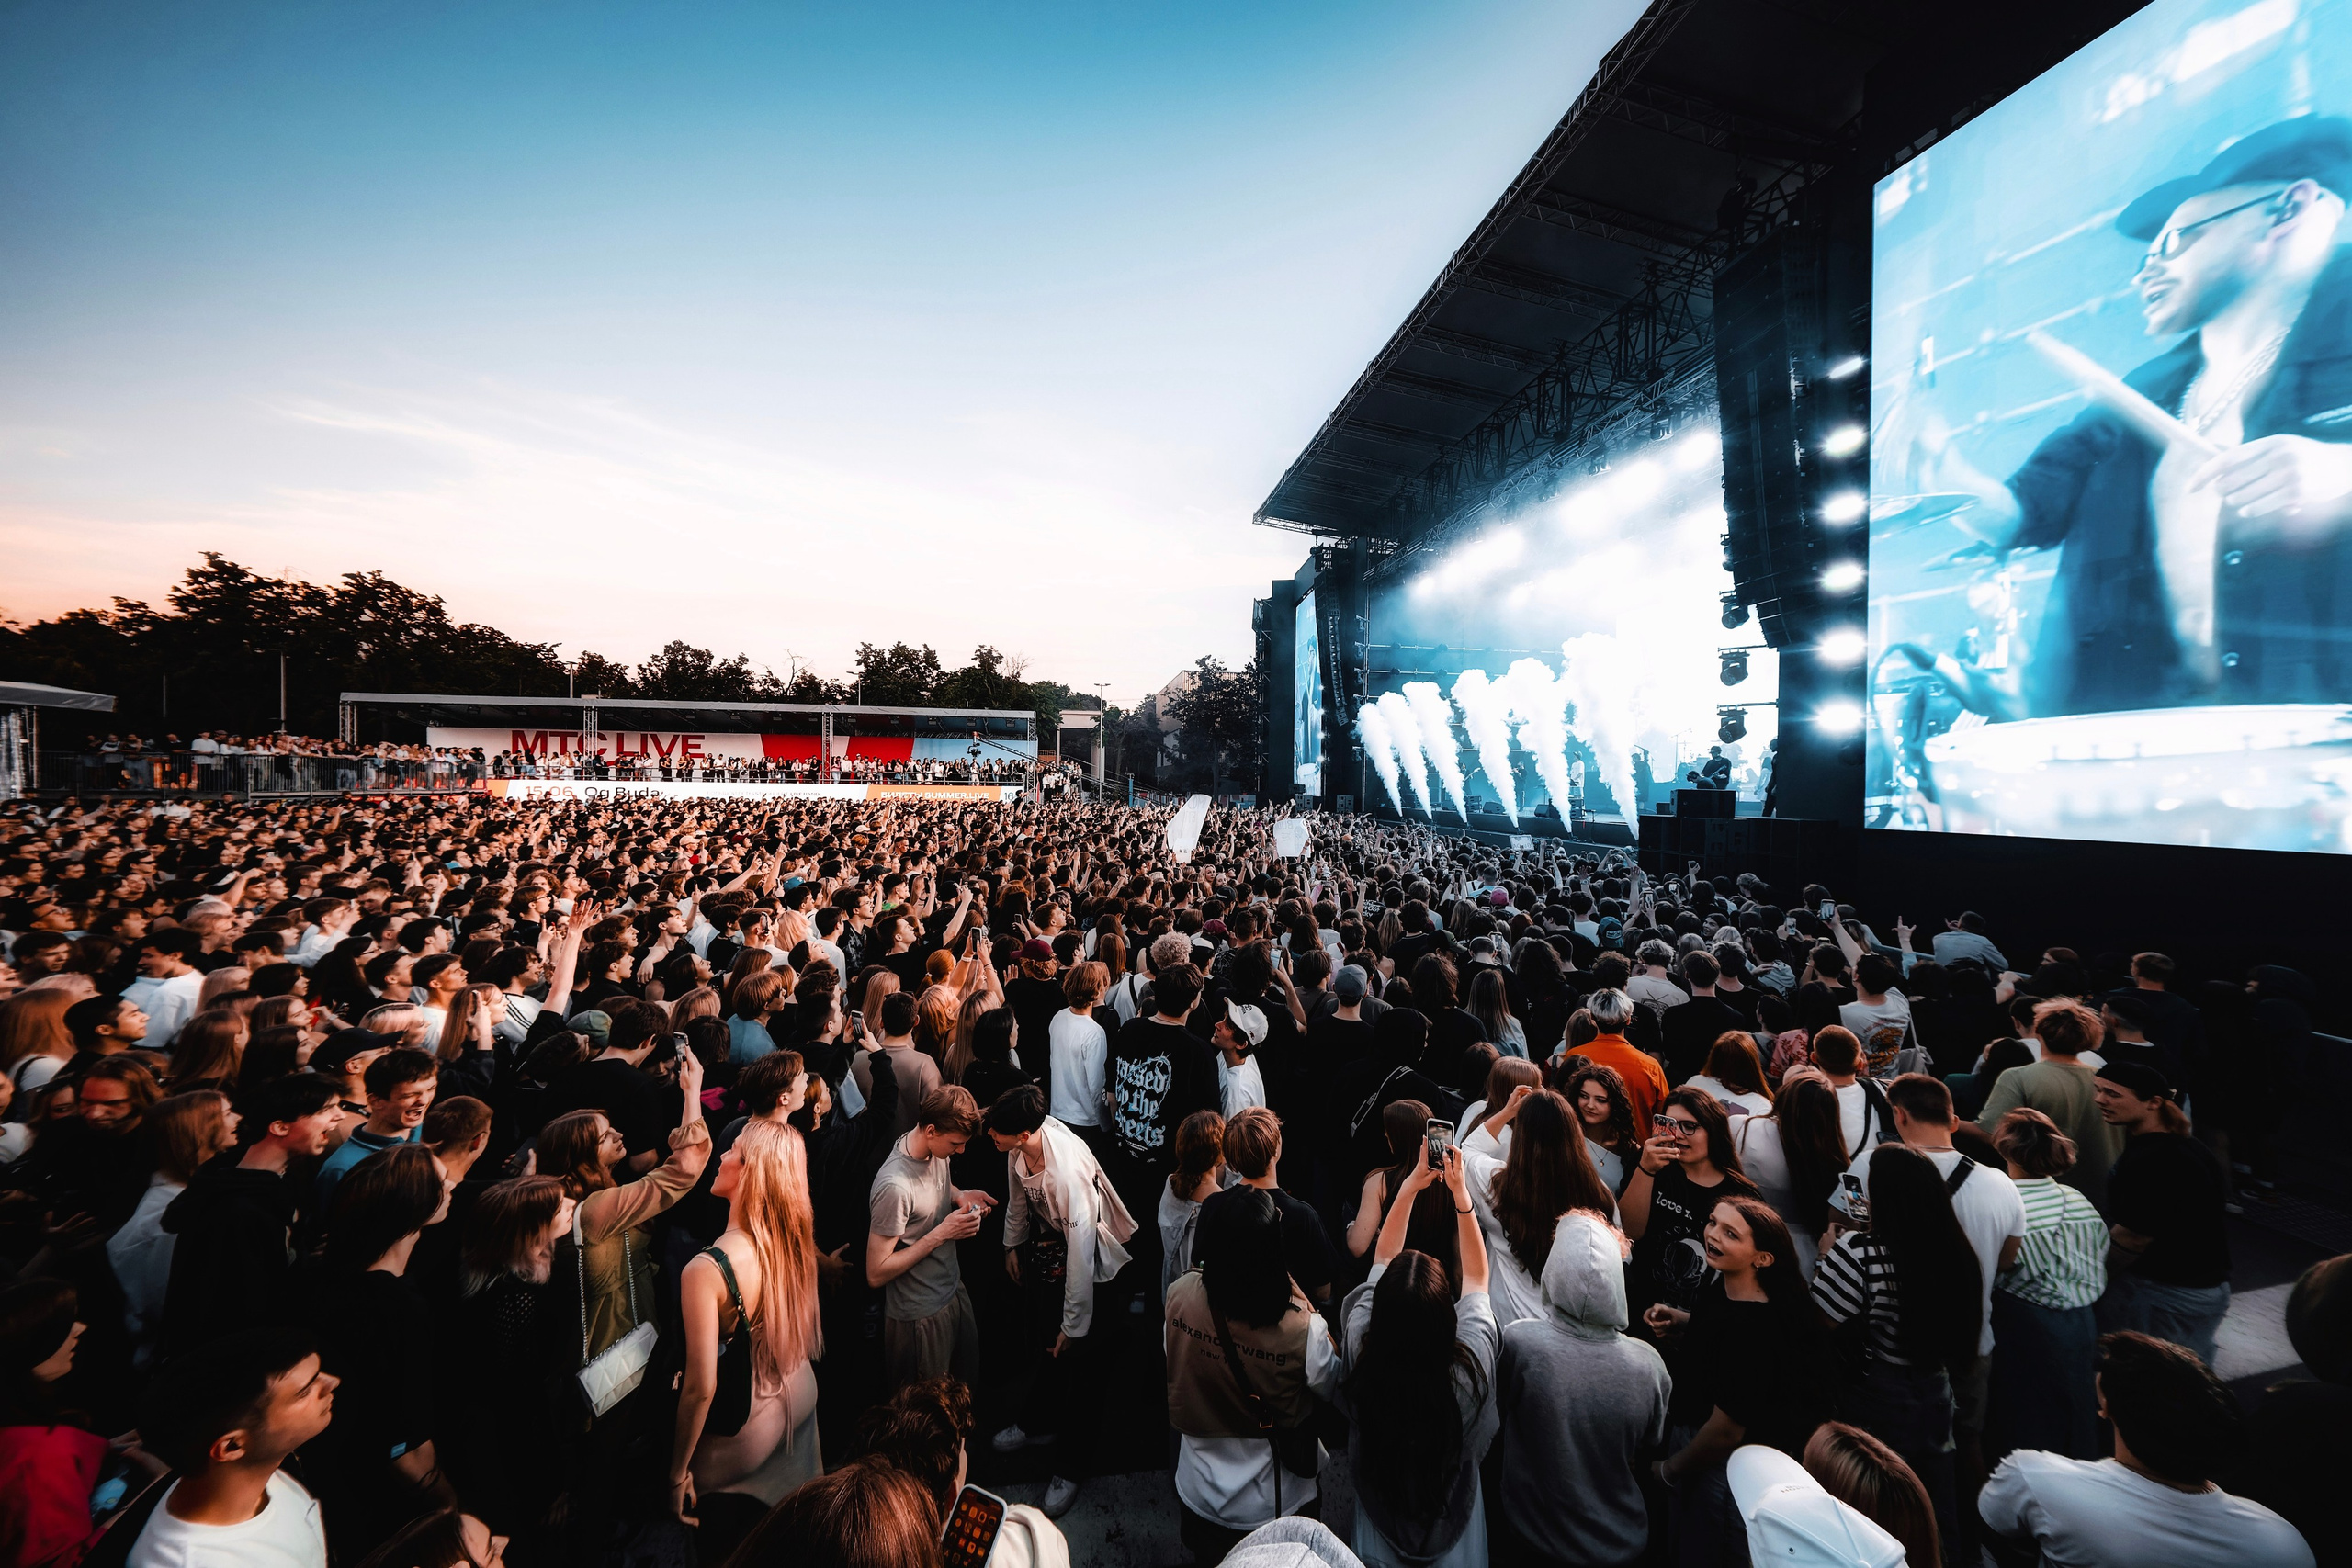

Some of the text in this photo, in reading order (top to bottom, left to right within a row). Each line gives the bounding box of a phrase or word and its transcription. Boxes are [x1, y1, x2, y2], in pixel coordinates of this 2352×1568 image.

[616, 733, 706, 759] LIVE
[585, 787, 609, 798] Og
[616, 787, 660, 797] Buda
[1129, 1088, 1159, 1120] the
[1656, 1190, 1683, 1213] love
[1172, 1317, 1287, 1366] alexandrwang
